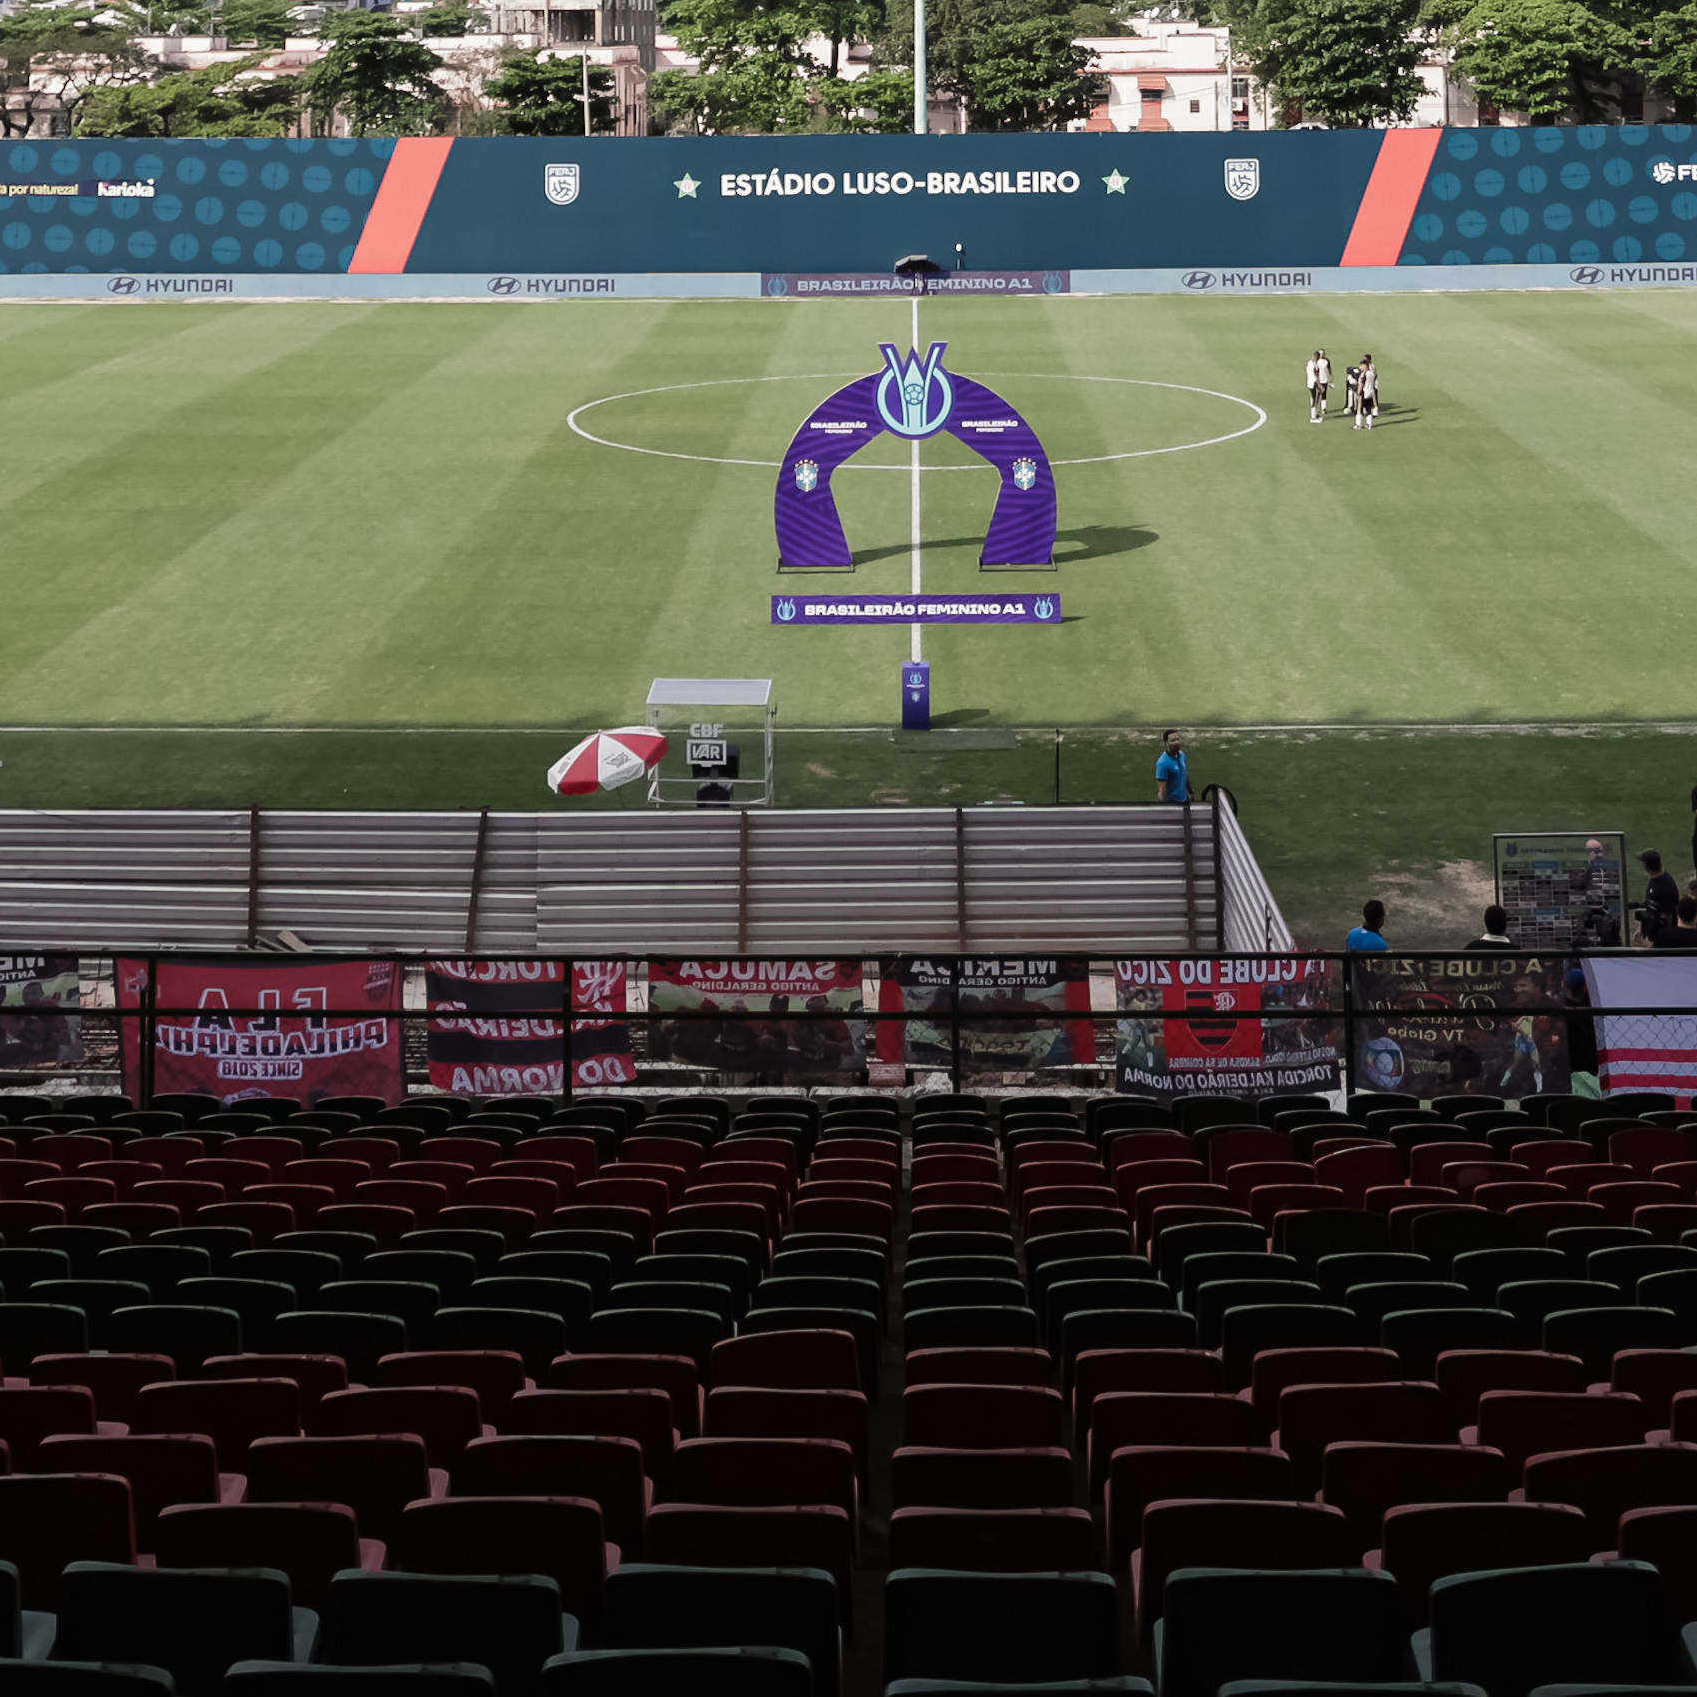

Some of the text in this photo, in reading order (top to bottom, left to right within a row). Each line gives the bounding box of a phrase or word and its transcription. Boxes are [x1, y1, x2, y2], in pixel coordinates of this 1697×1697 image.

[1228, 162, 1256, 171] FERJ
[720, 168, 1081, 196] ESTÁDIO LUSO-BRASILEIRO
[8, 184, 29, 196] por
[146, 279, 233, 293] HYUNDAI
[527, 279, 615, 293] HYUNDAI
[797, 277, 1032, 292] BRASILEIRÃO EMININO A1
[1222, 272, 1312, 287] HYUNDAI
[804, 602, 1026, 616] BRASILEIRÃO FEMININO A1
[690, 724, 723, 738] CBF
[692, 744, 721, 759] VAR
